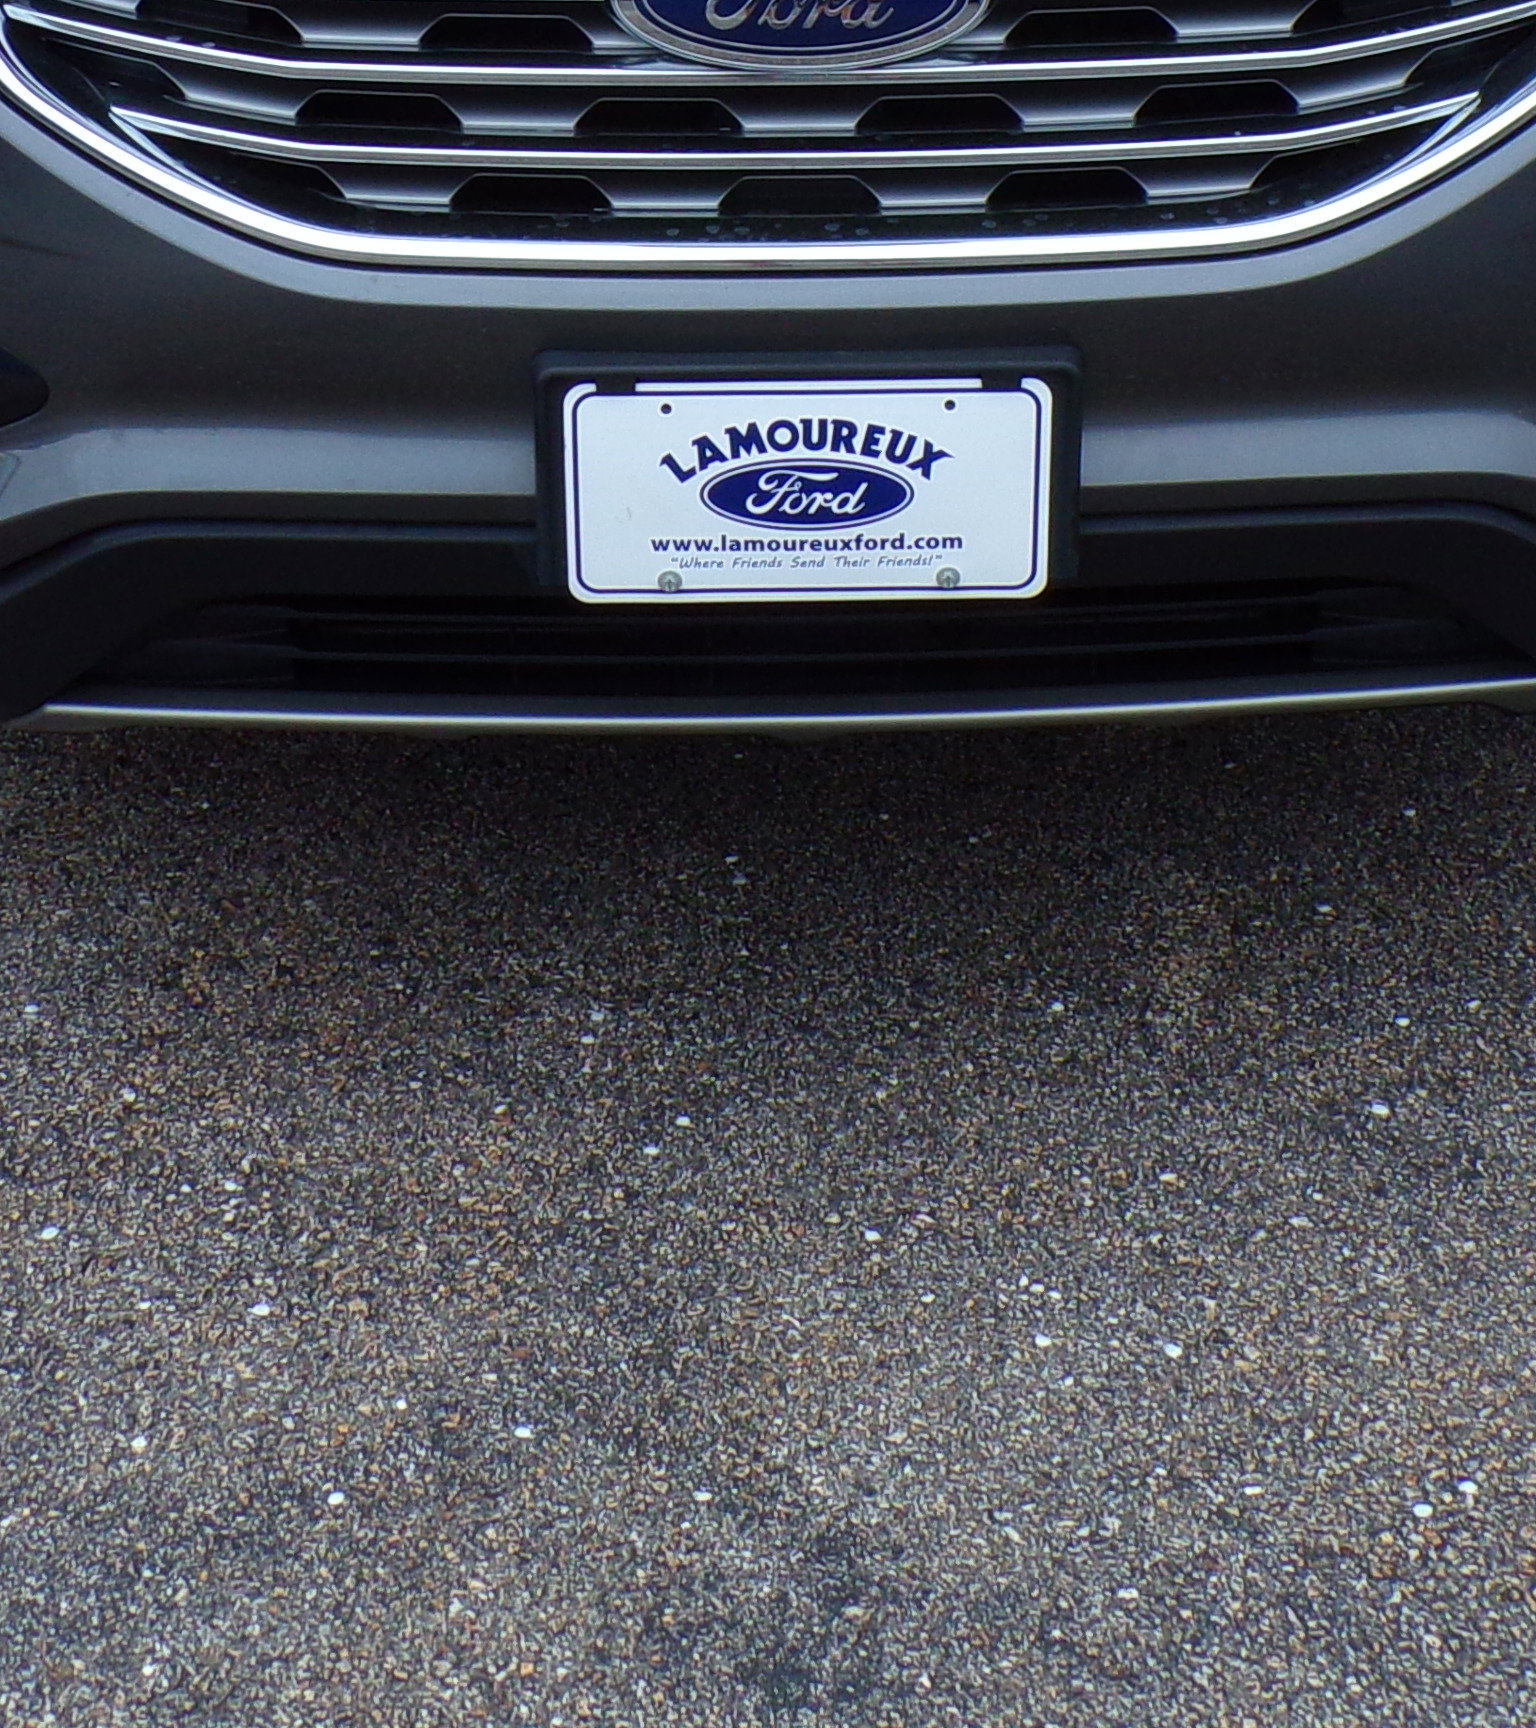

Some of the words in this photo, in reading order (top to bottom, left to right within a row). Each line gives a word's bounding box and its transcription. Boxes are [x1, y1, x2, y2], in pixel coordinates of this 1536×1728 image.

[659, 418, 955, 484] LAMOUREUX
[745, 469, 869, 515] Ford
[651, 532, 963, 552] www.lamoureuxford.com
[671, 556, 724, 569] "Where
[732, 556, 783, 569] Friends
[790, 555, 826, 569] Send
[834, 555, 871, 568] Their
[877, 554, 943, 567] Friends!"
